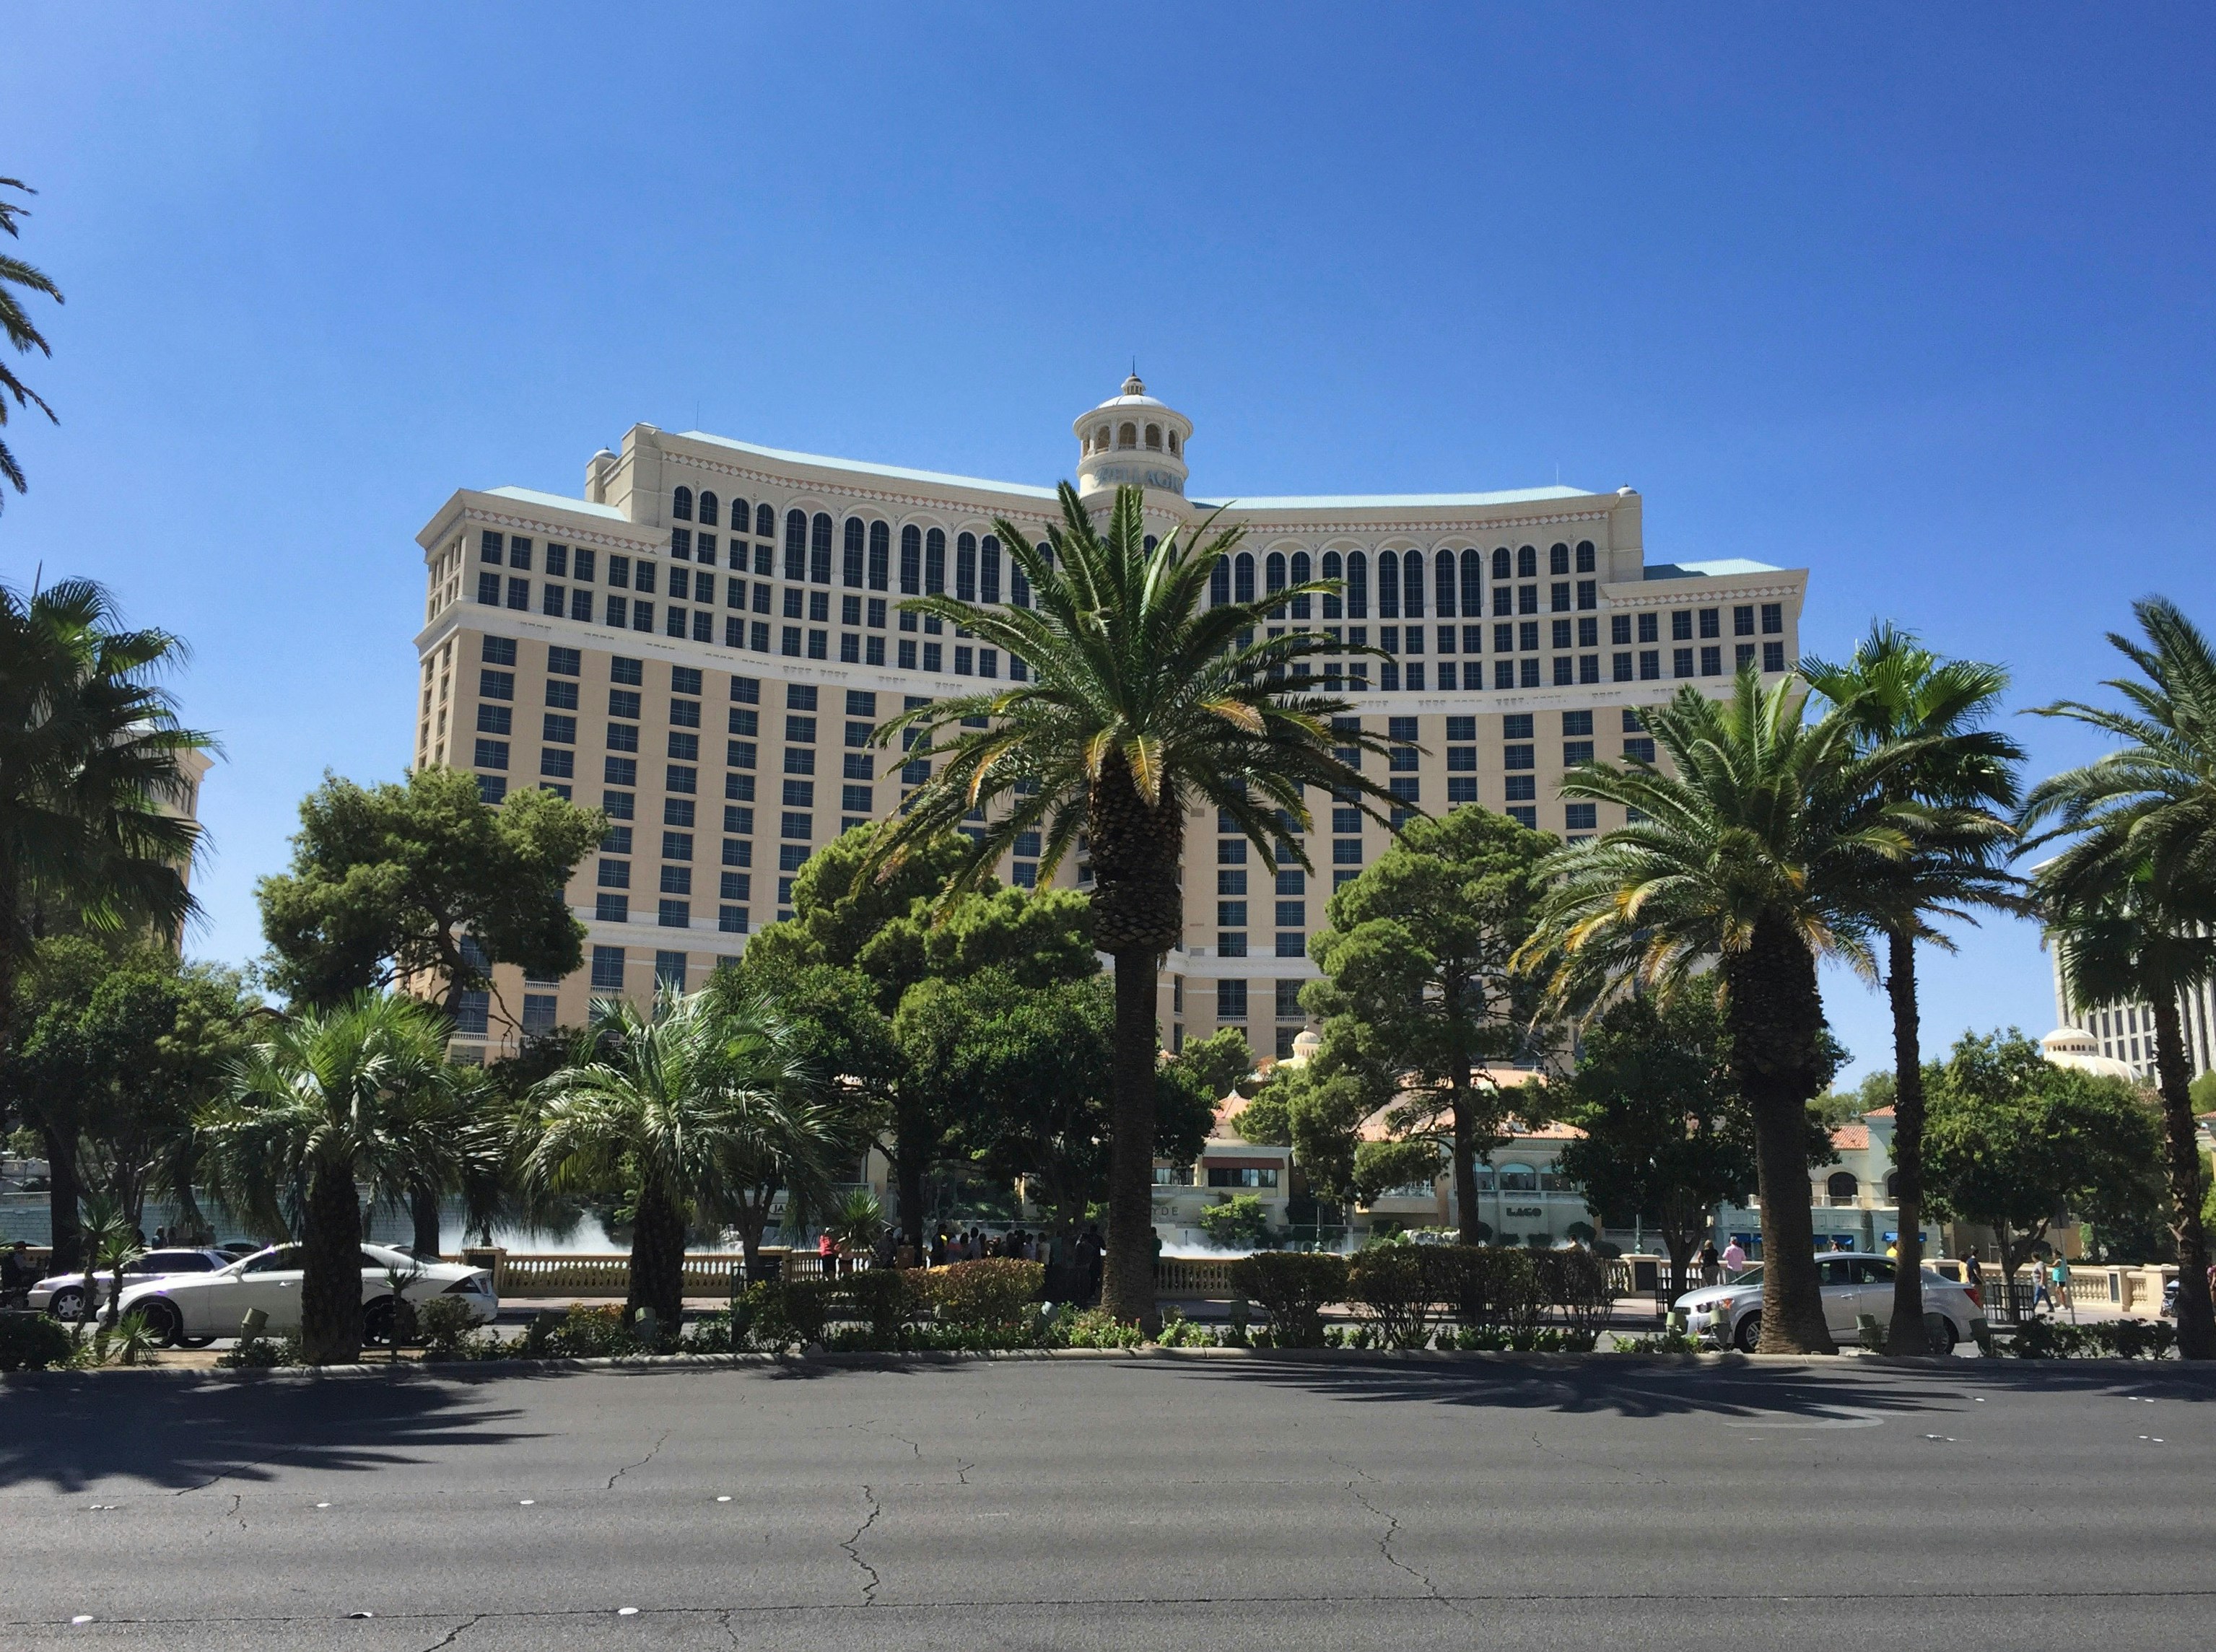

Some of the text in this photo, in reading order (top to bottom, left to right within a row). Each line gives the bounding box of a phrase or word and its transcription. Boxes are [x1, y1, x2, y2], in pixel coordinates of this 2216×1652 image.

[1094, 466, 1183, 494] BELLAGIO
[1151, 1206, 1179, 1216] YDE
[1506, 1207, 1542, 1217] LAGO
